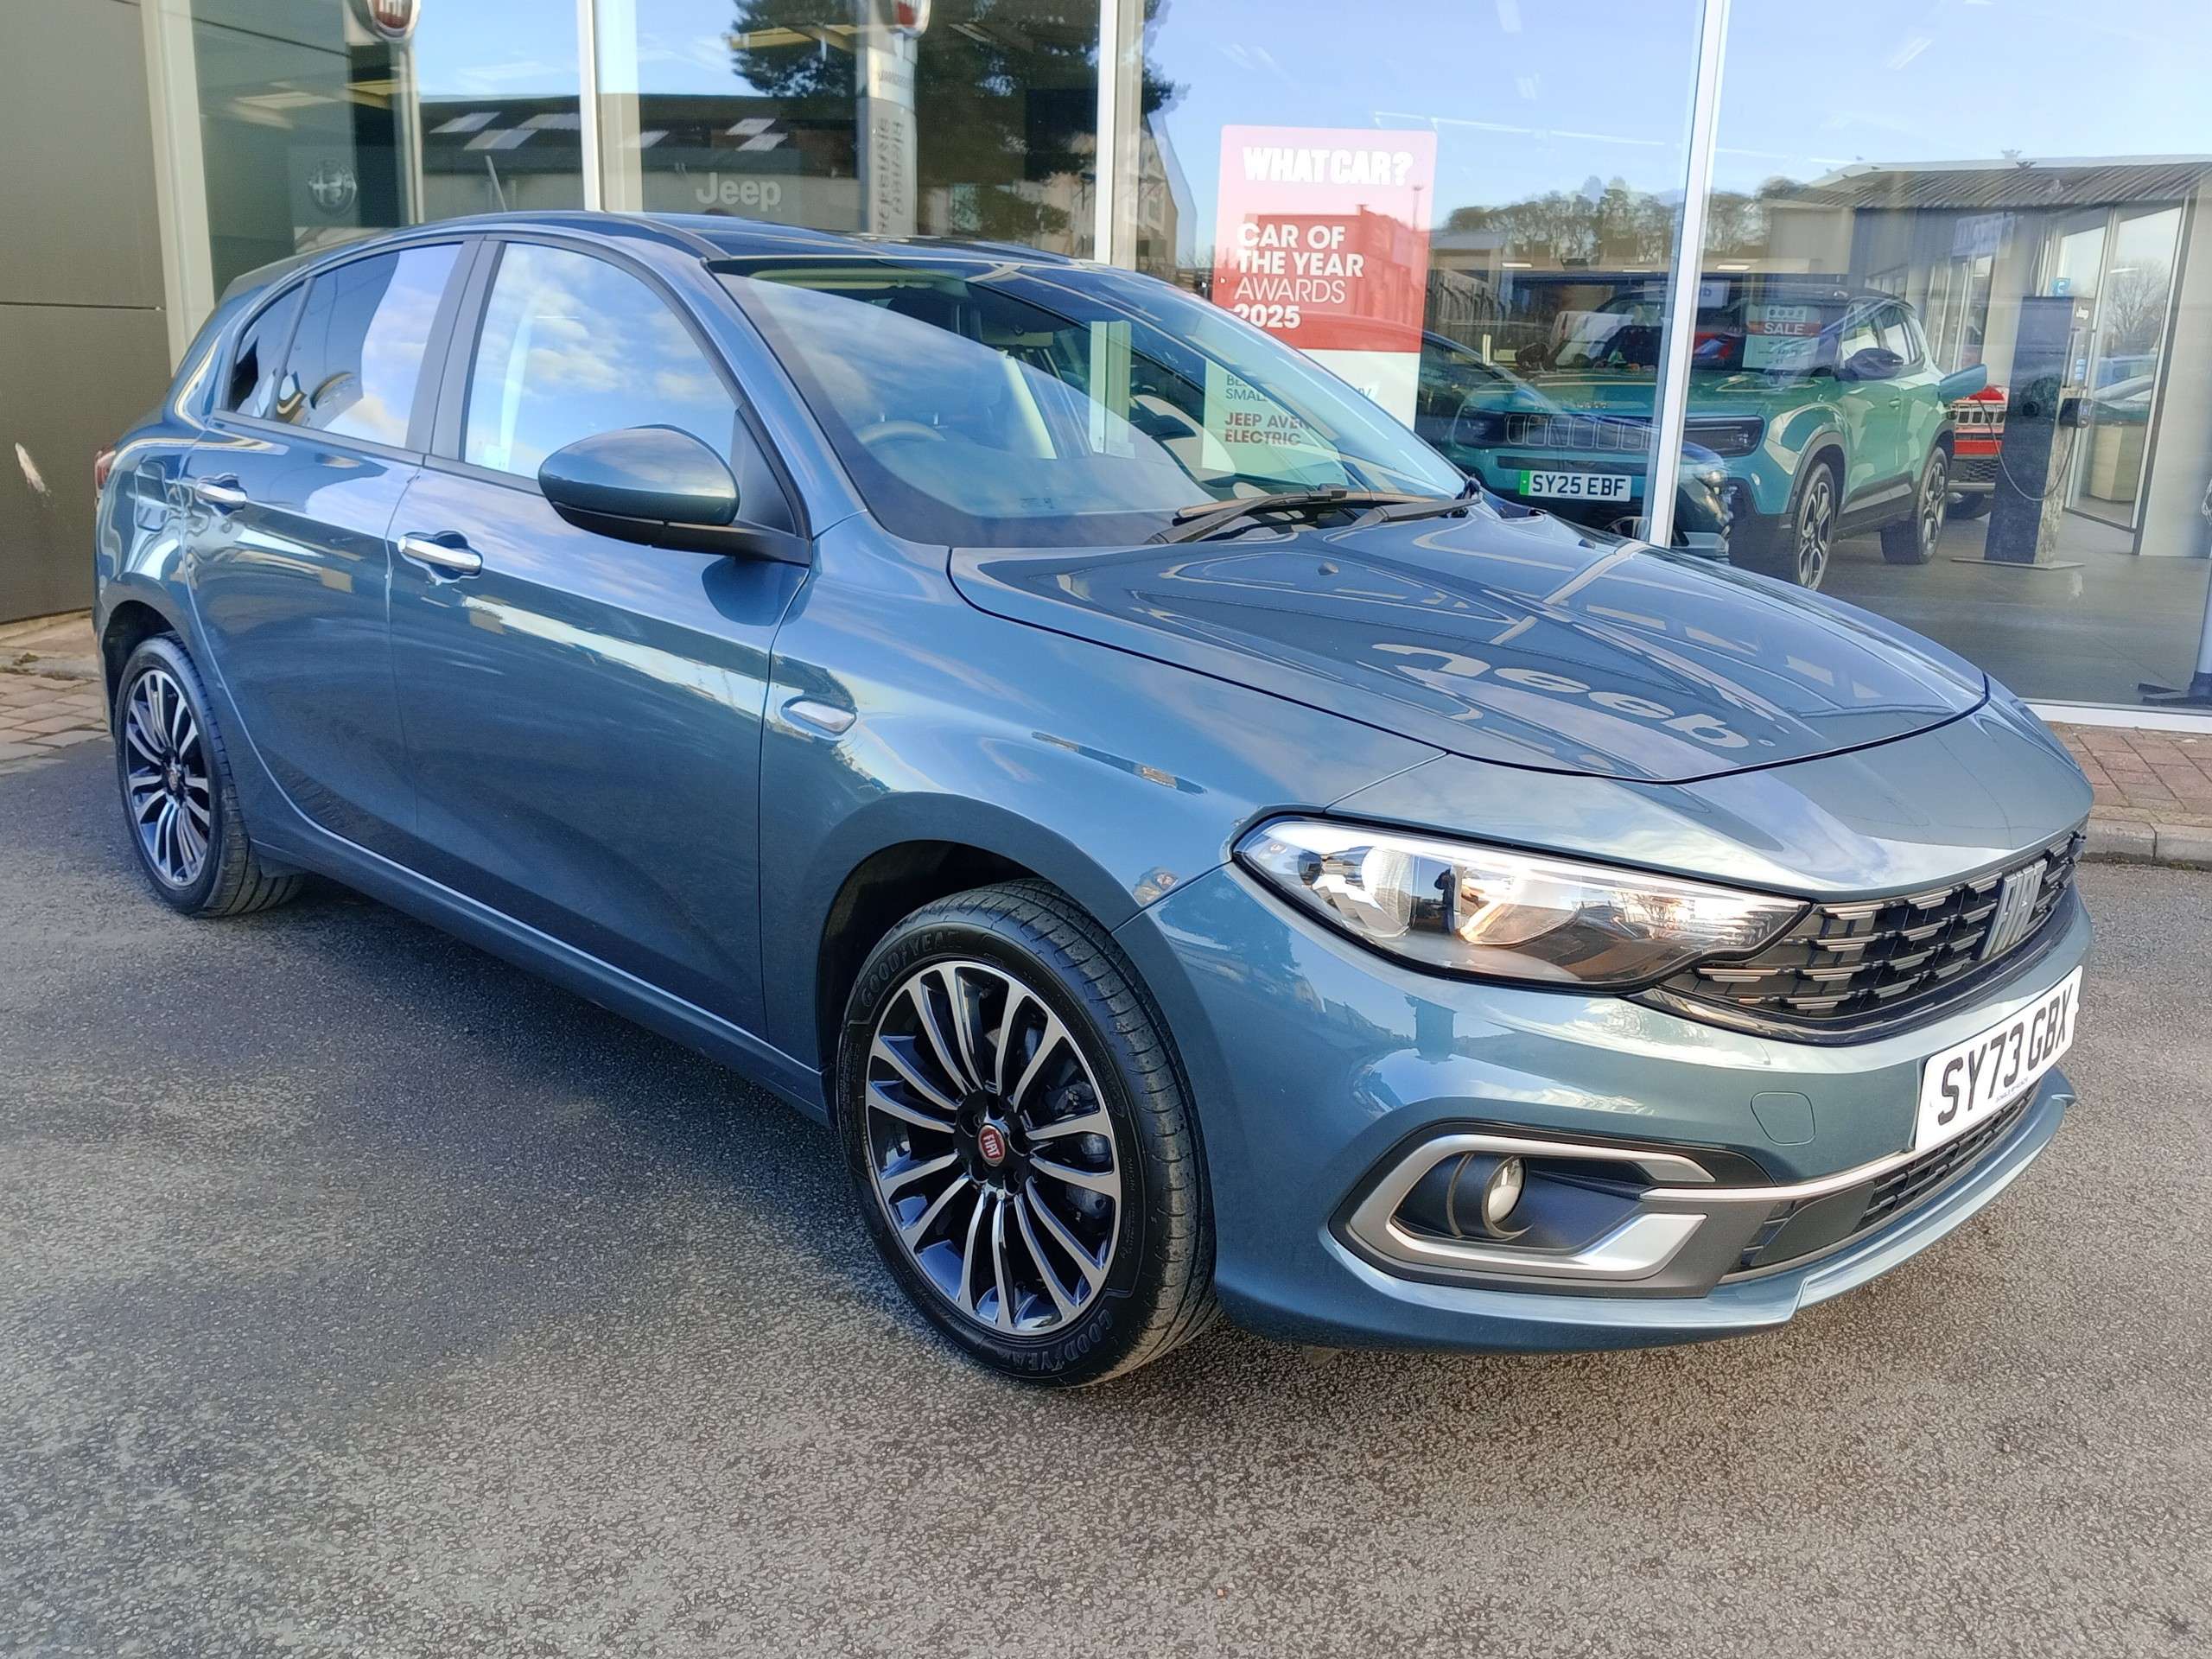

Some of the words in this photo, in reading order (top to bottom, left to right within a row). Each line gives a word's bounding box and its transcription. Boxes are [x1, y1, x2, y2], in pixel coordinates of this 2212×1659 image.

[1243, 146, 1331, 184] WHAT
[1331, 149, 1414, 187] CAR?
[695, 172, 782, 212] Jeep
[1236, 222, 1300, 249] CAR
[1306, 225, 1345, 250] OF
[1236, 249, 1287, 275] THE
[1292, 251, 1364, 277] YEAR
[1234, 276, 1346, 303] AWARDS
[1233, 303, 1300, 328] 2025
[1764, 322, 1805, 335] SALE
[1225, 388, 1268, 402] SMAL
[1224, 412, 1262, 427] JEEP
[1267, 415, 1309, 429] AVEN
[1224, 429, 1301, 446] ELECTRIC
[1532, 474, 1582, 495] SY25
[1586, 477, 1626, 497] EBF
[1937, 1021, 2024, 1126] SY73
[2027, 983, 2074, 1071] GBX
[982, 1133, 1001, 1157] FIAT
